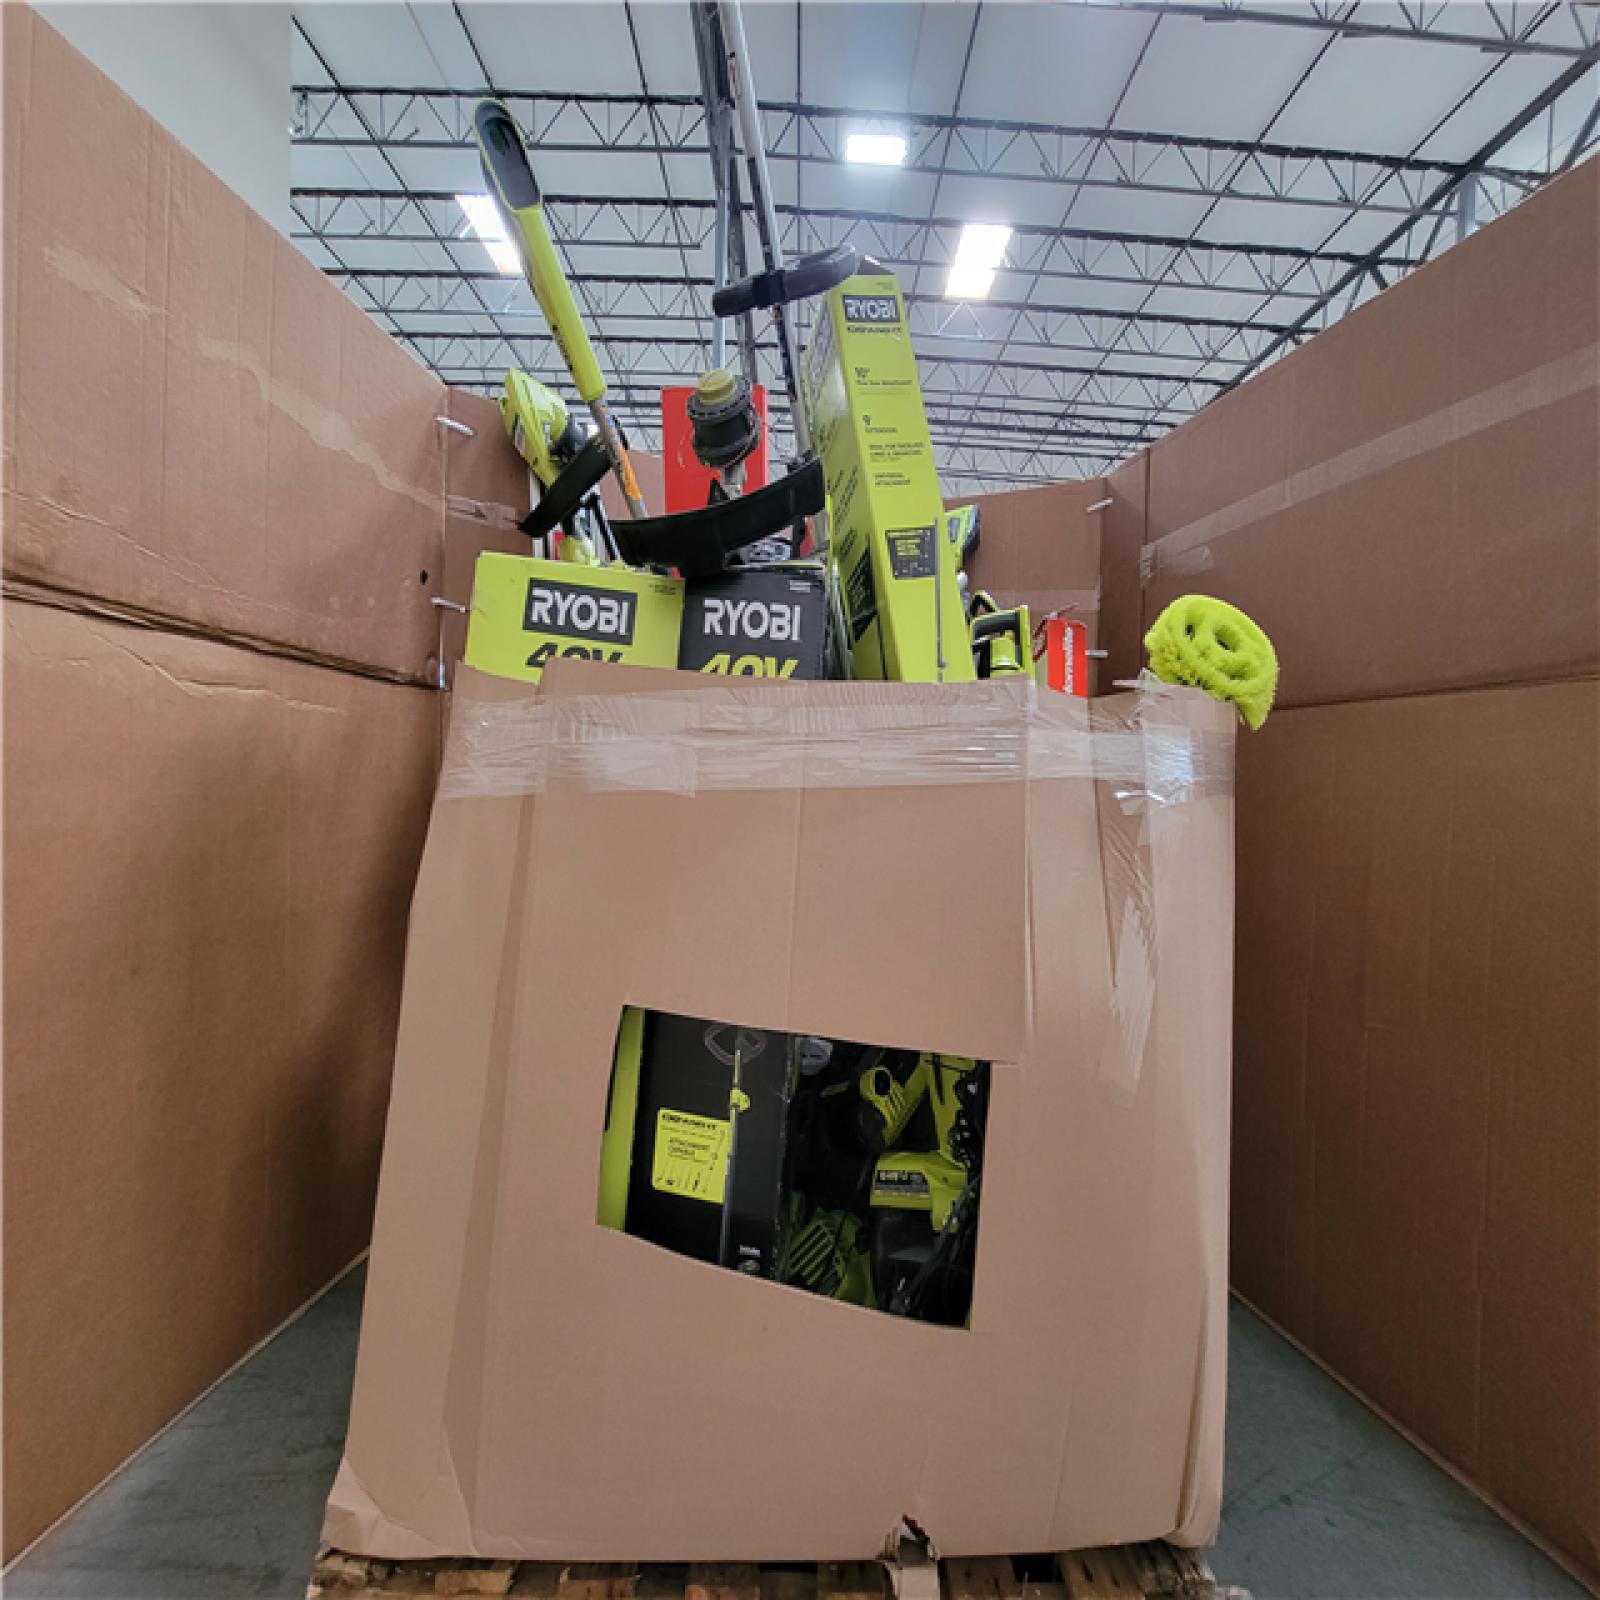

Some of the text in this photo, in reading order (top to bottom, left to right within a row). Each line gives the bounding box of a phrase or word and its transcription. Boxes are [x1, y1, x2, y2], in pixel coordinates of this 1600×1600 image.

[844, 299, 898, 319] RYOBI
[531, 586, 630, 636] RYOBI
[703, 598, 801, 641] RYOBI
